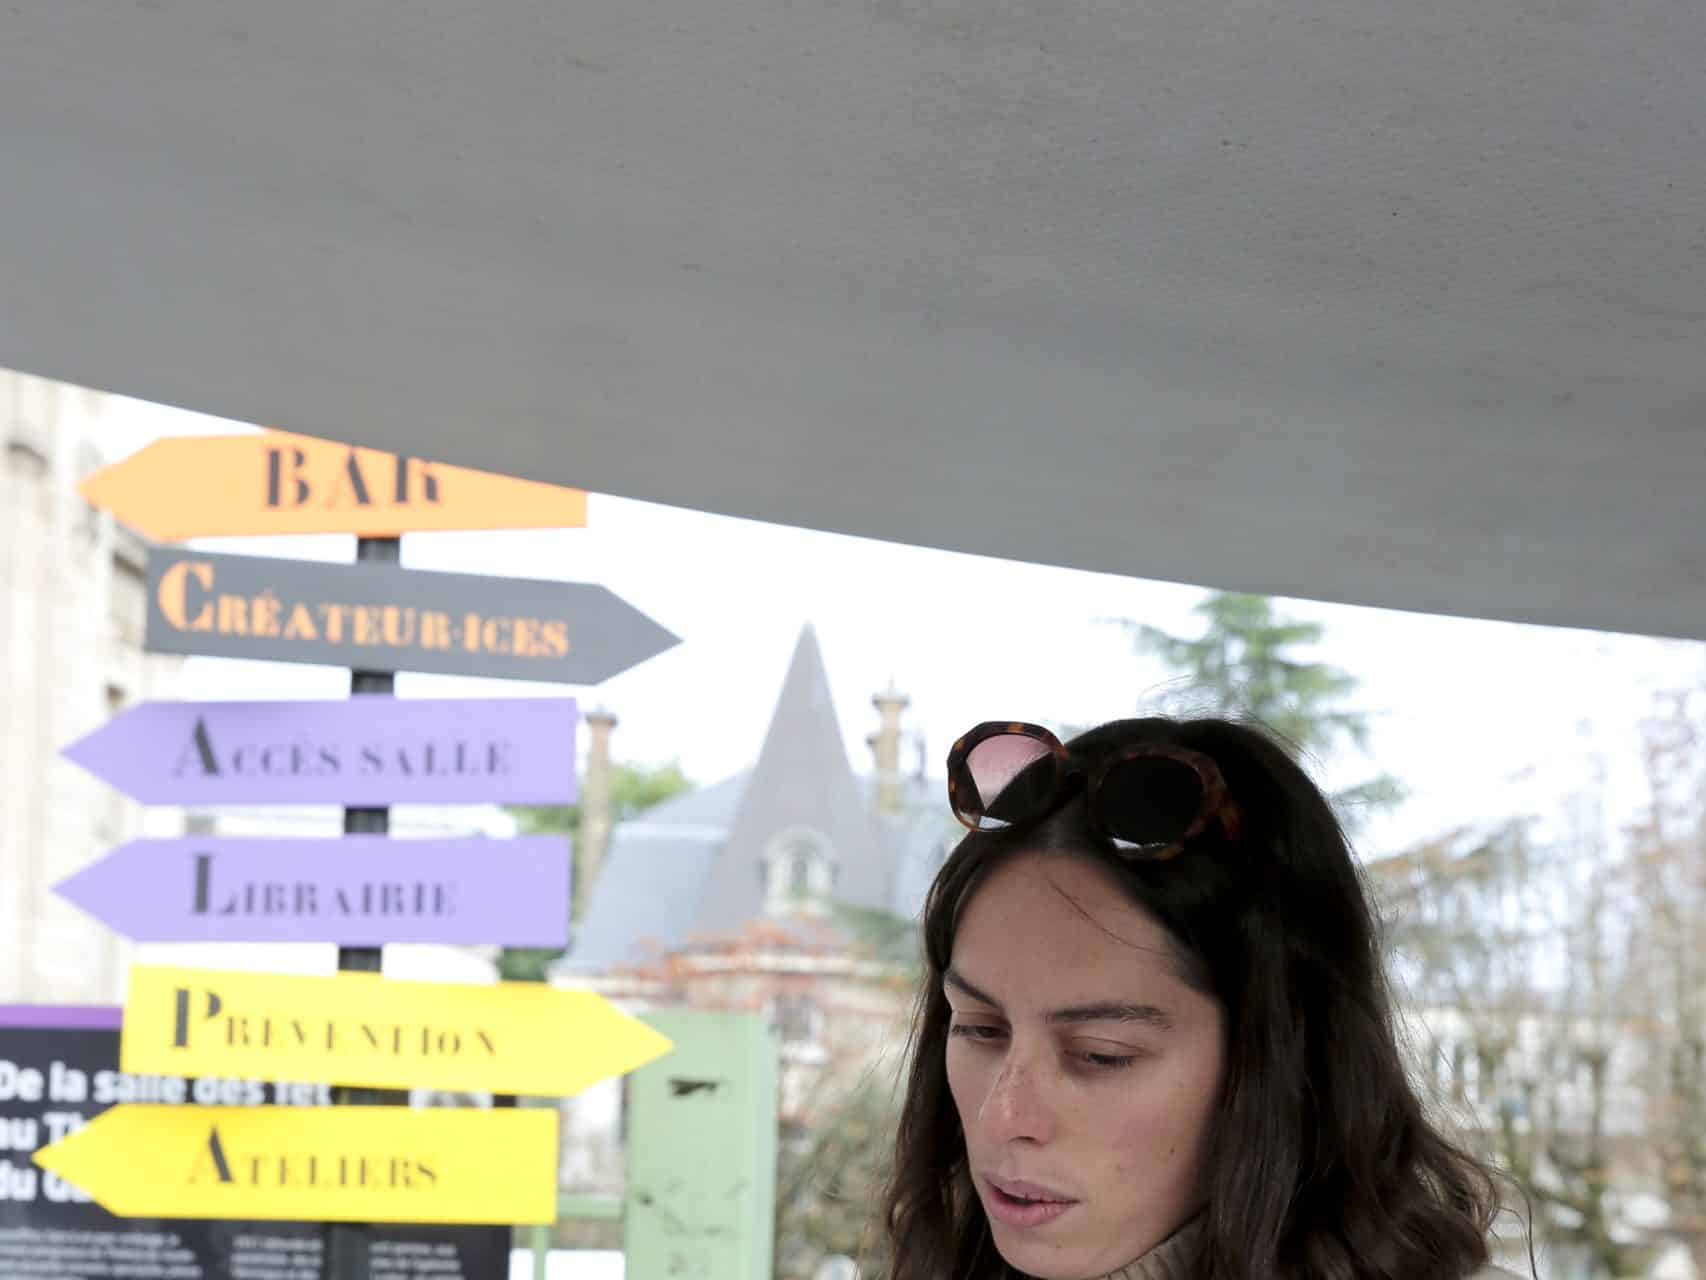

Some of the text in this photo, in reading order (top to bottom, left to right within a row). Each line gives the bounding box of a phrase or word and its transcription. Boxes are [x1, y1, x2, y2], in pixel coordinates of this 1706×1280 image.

[264, 446, 440, 507] BAR
[359, 741, 513, 777] SALLE
[188, 852, 458, 918] LIBRAIRIE
[50, 1061, 88, 1103] la
[187, 1125, 439, 1188] ATELIERS
